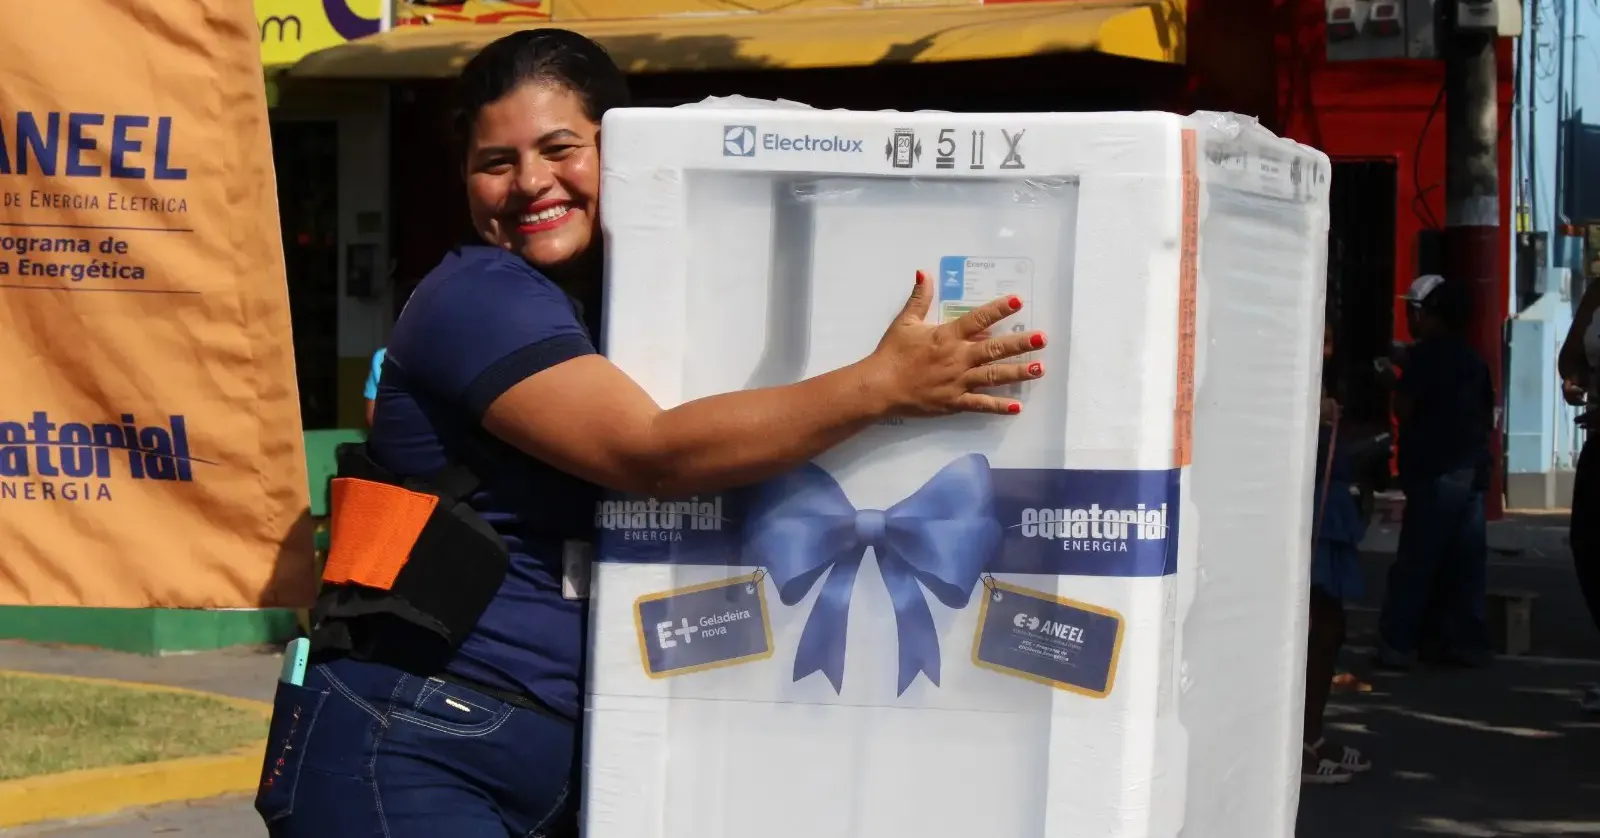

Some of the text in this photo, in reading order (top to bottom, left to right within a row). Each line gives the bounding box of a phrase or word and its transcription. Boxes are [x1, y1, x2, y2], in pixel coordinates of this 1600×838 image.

[0, 111, 188, 181] NEEL
[762, 133, 863, 153] Electrolux
[898, 137, 910, 148] 20
[936, 128, 956, 157] 5
[4, 192, 20, 207] DE
[30, 190, 99, 210] ENERGIA
[0, 236, 128, 255] ograma de
[18, 259, 145, 282] Energética
[2, 482, 112, 501] NERGIA
[1021, 503, 1167, 540] equatorial
[624, 531, 682, 541] ENERGIA
[1063, 540, 1128, 552] ENERGIA
[699, 608, 750, 628] Geladeira
[701, 626, 727, 639] nova
[1040, 620, 1084, 644] ANEEL
